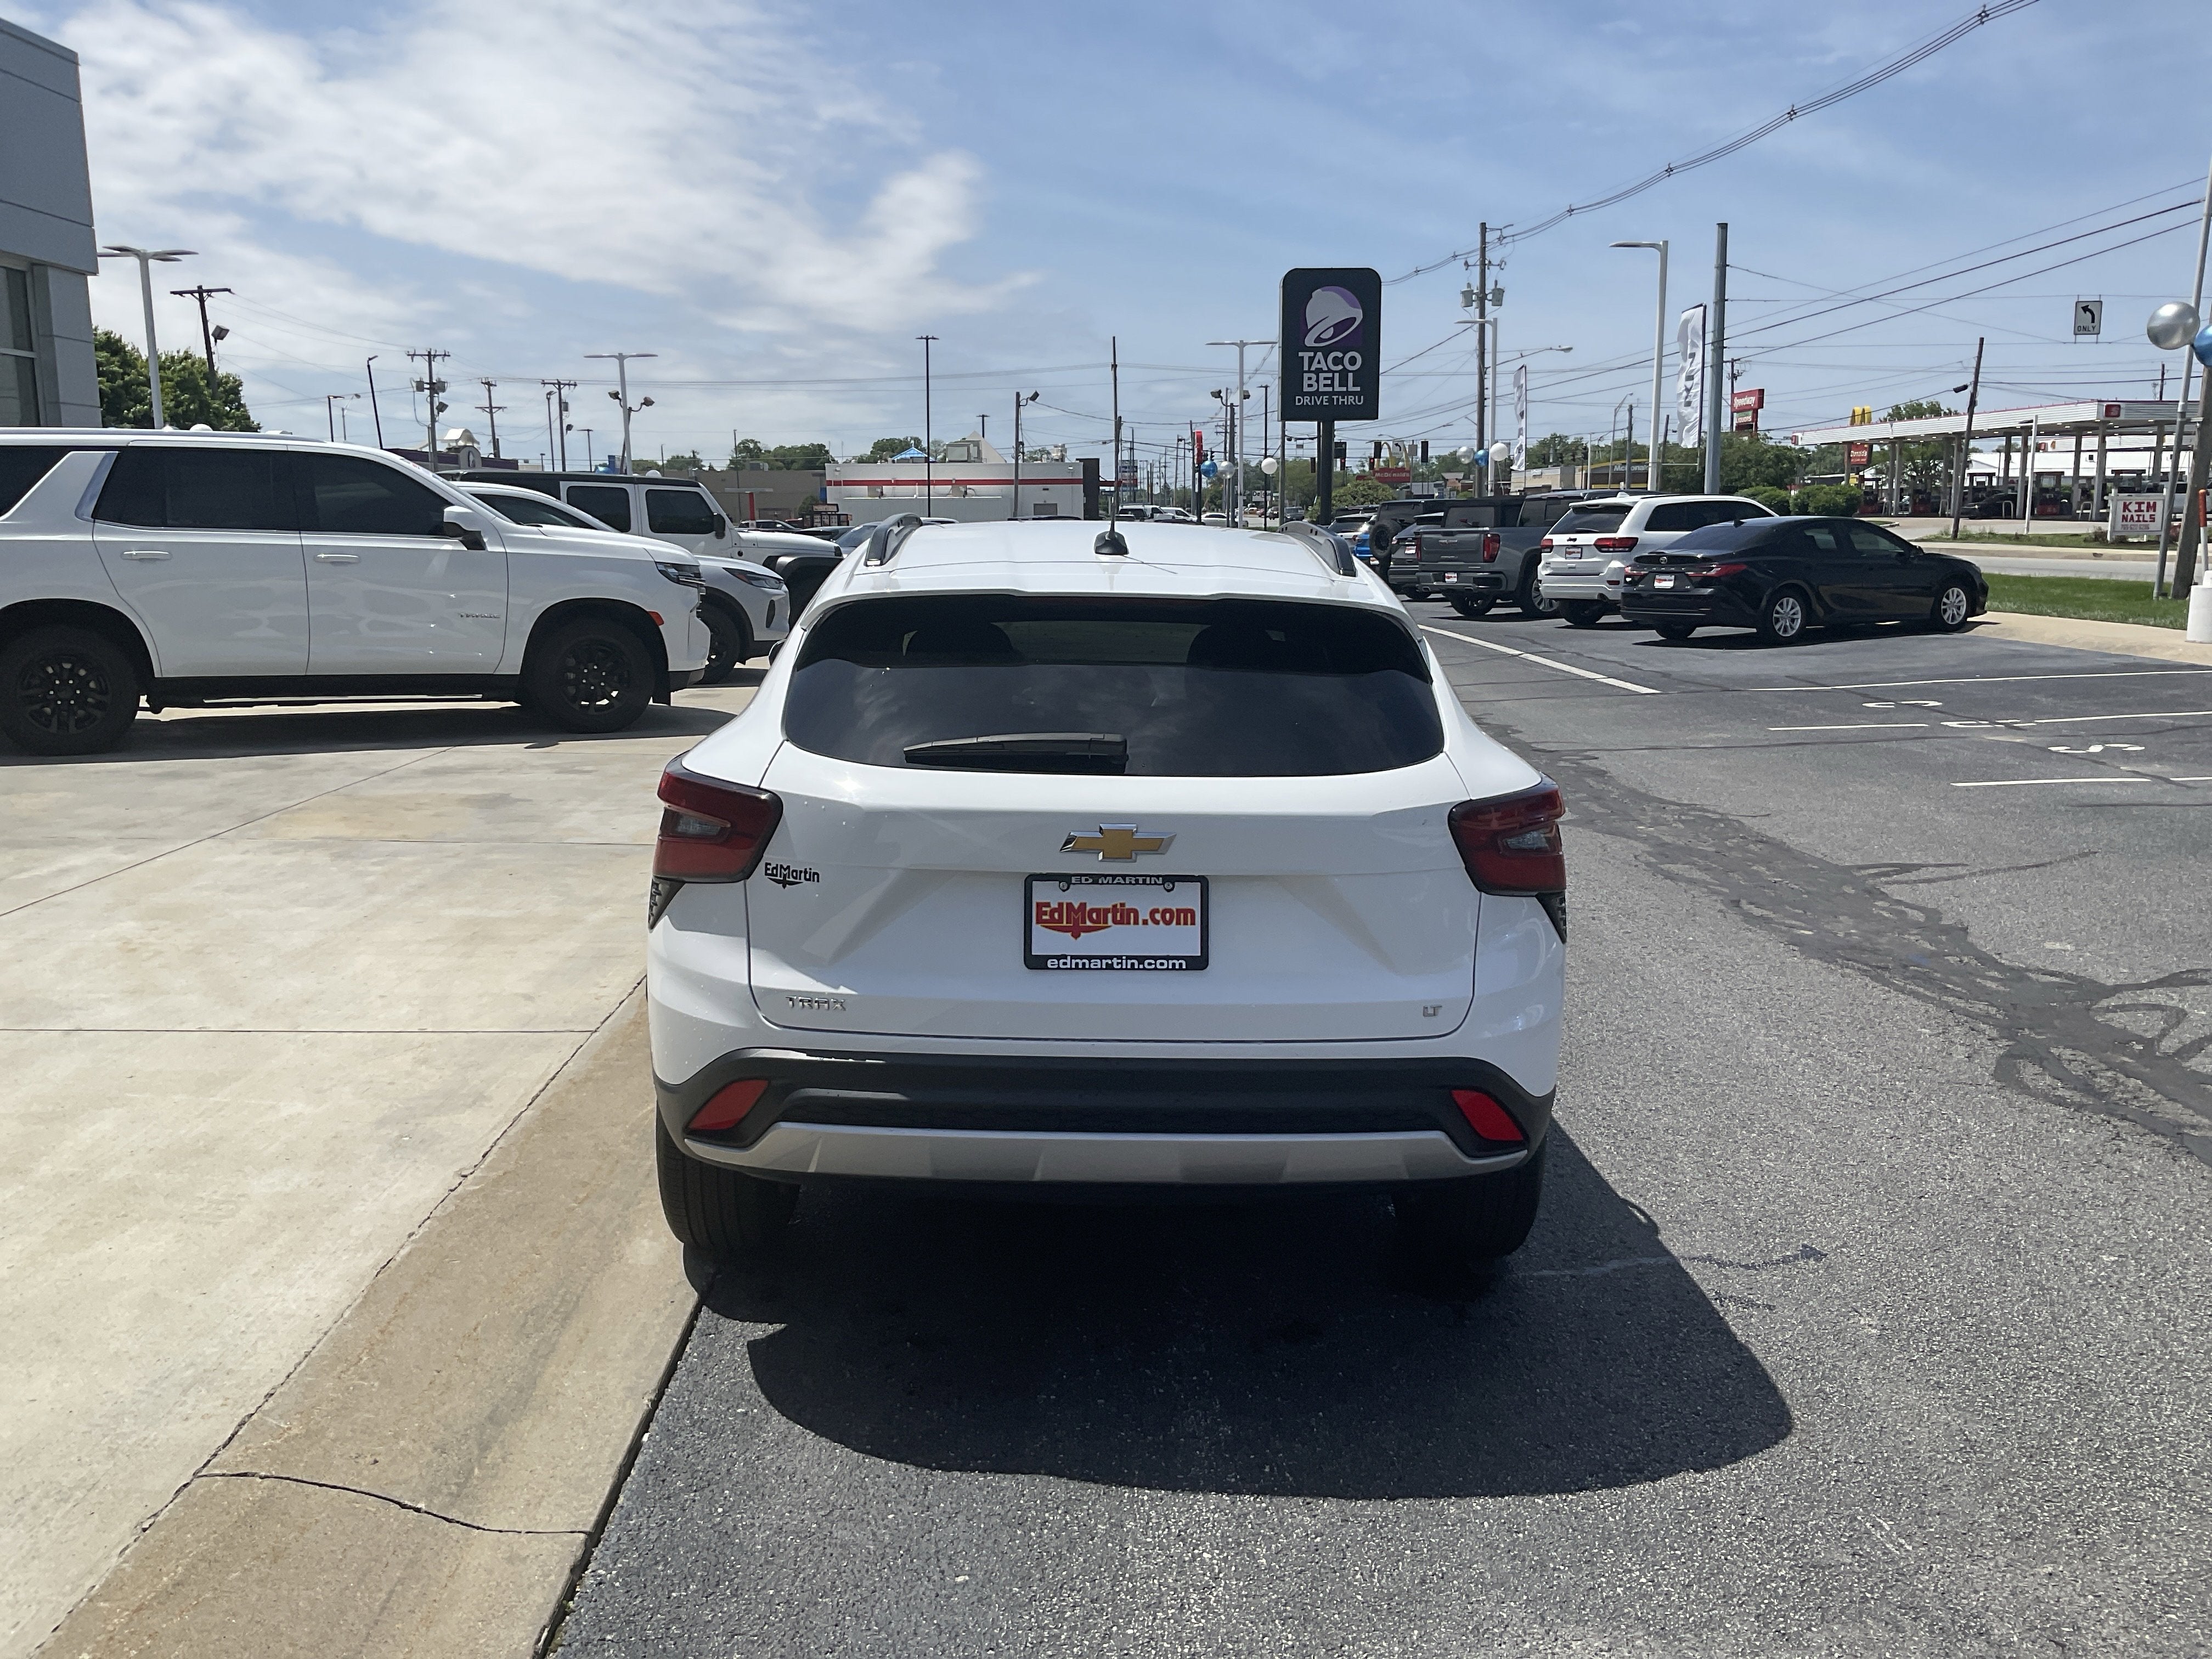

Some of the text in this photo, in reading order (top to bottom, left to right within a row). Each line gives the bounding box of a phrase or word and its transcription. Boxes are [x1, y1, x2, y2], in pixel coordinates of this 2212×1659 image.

[1298, 351, 1362, 371] TACO
[1302, 373, 1361, 392] BELL
[1295, 396, 1363, 405] DRIVE THRU
[2122, 501, 2157, 512] KIM
[2121, 514, 2155, 522] NAILS
[765, 862, 820, 883] EdMartin
[1036, 901, 1196, 926] EdMartin.com
[1047, 956, 1186, 969] edmartin.com
[785, 996, 846, 1011] TRAX
[1423, 1005, 1442, 1017] LT
